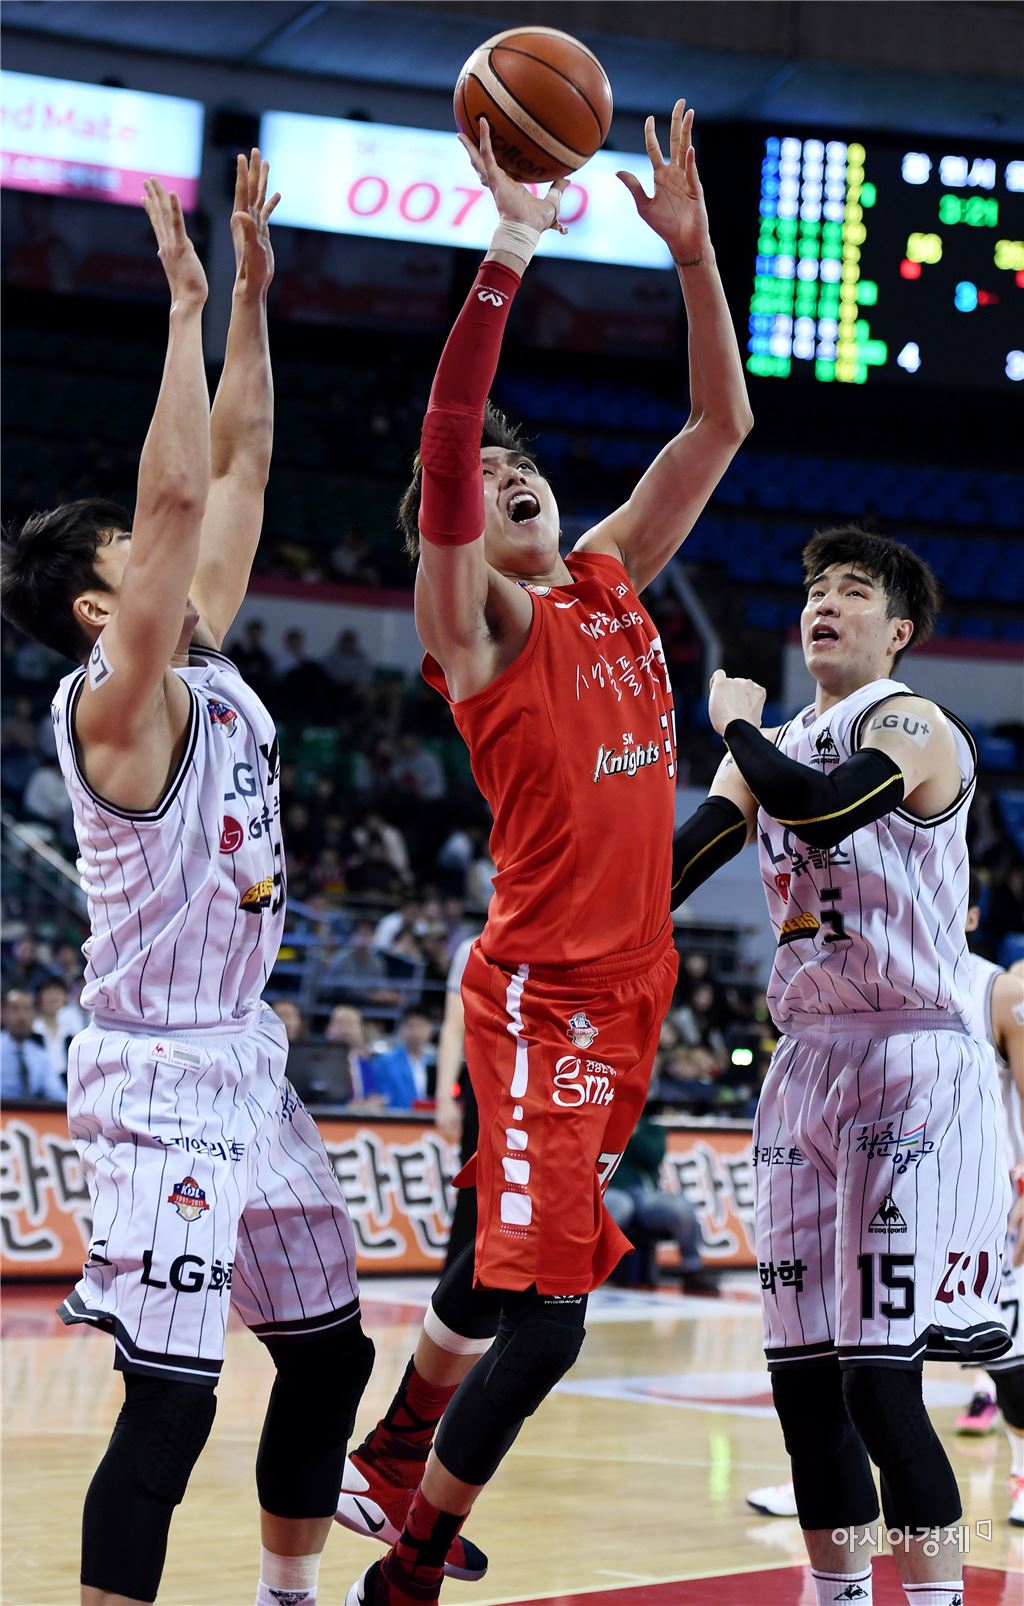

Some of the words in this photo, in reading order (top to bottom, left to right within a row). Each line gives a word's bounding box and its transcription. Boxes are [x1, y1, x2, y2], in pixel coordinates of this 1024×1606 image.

[346, 174, 591, 229] 0070
[870, 714, 900, 731] LG
[622, 732, 634, 745] SK
[592, 742, 660, 783] Knights
[887, 1226, 908, 1235] sportif
[857, 1252, 916, 1321] 15
